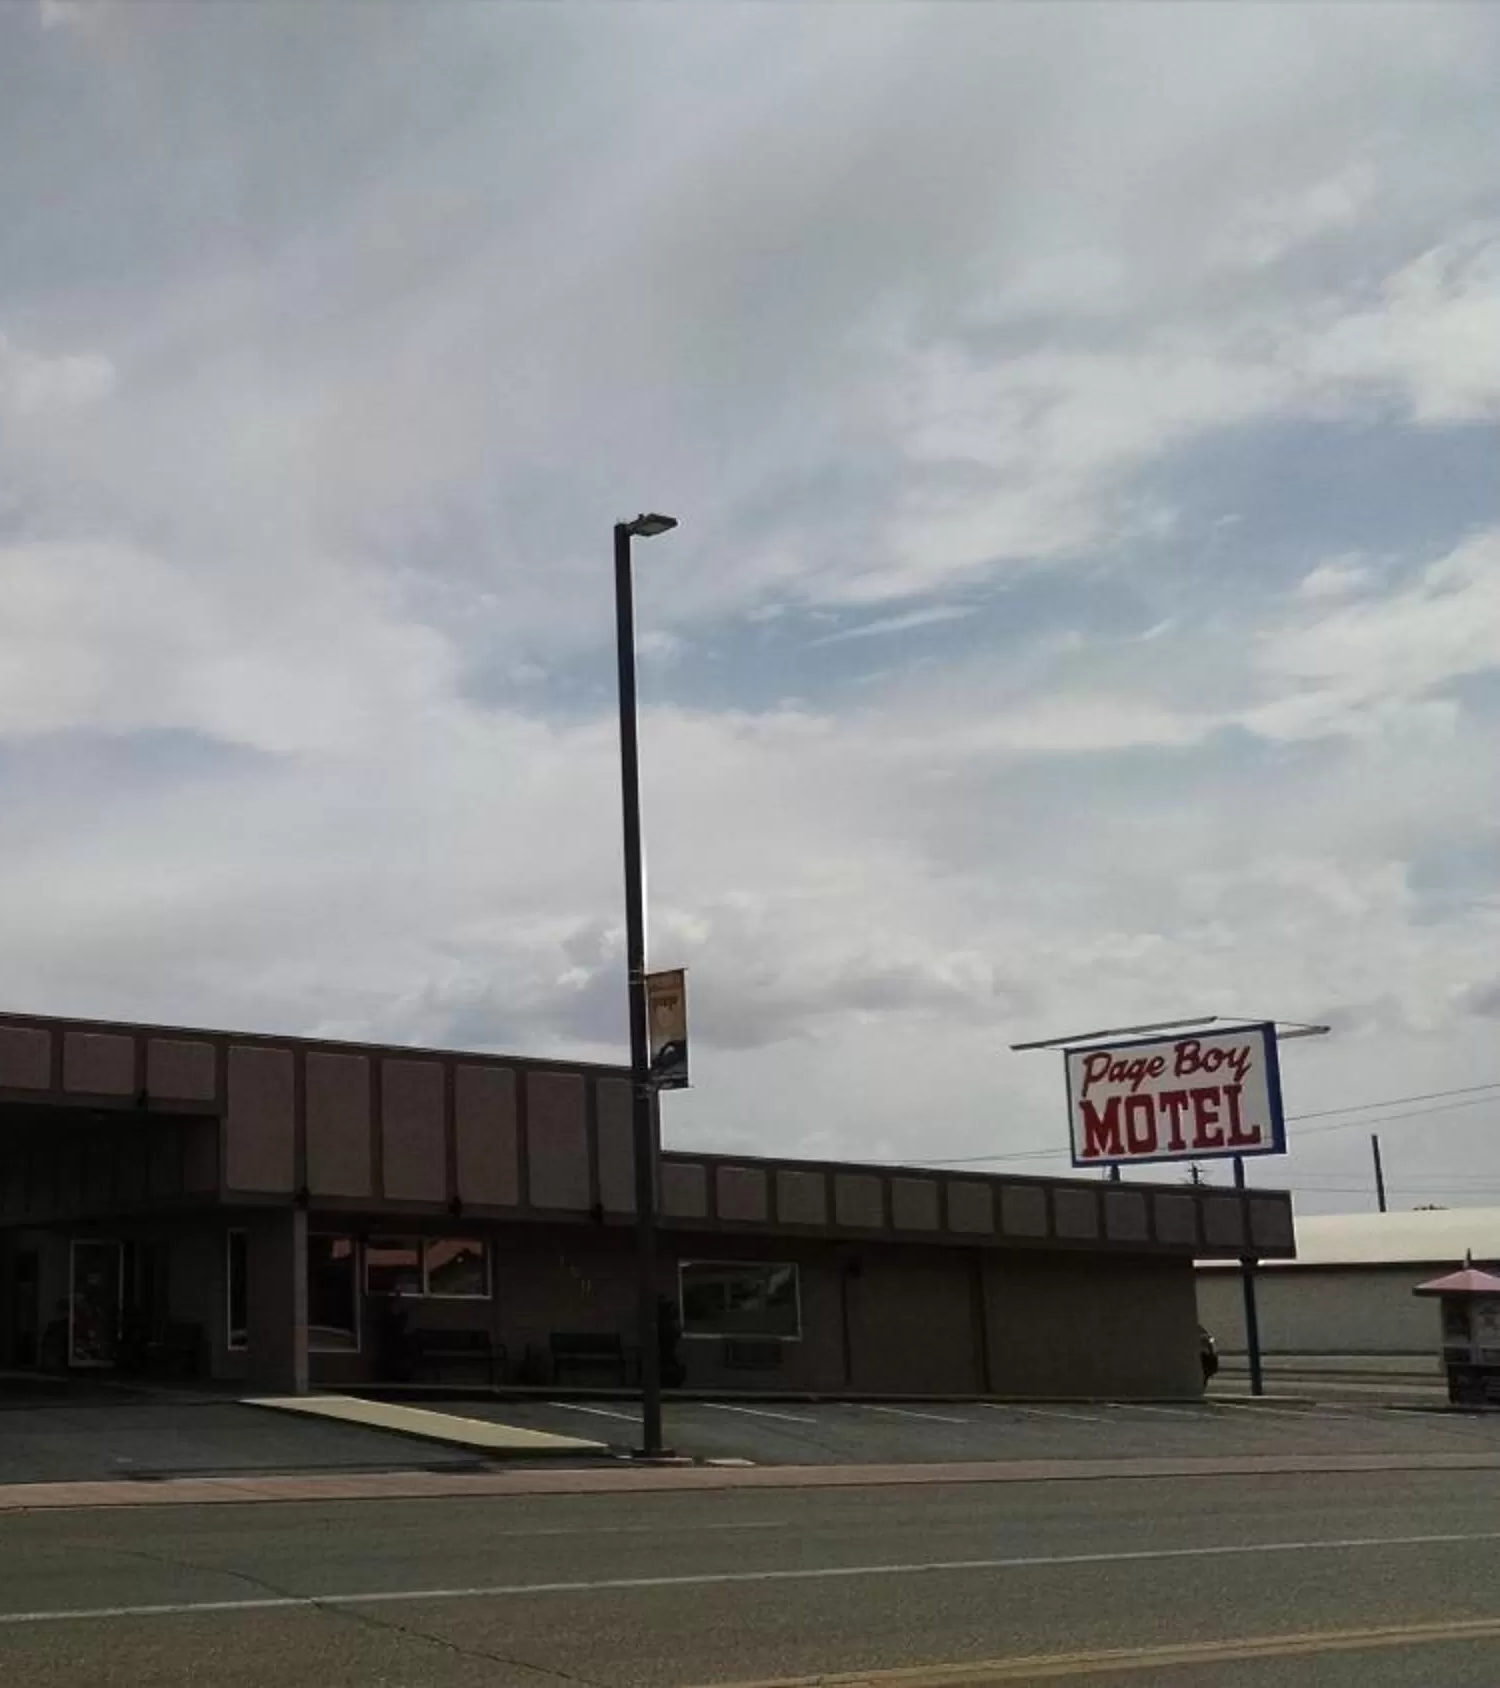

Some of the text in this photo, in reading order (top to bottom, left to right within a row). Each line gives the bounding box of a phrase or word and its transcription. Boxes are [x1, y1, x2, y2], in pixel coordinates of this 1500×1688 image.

[1082, 1039, 1252, 1097] Page Boy
[1079, 1083, 1262, 1158] MOTEL
